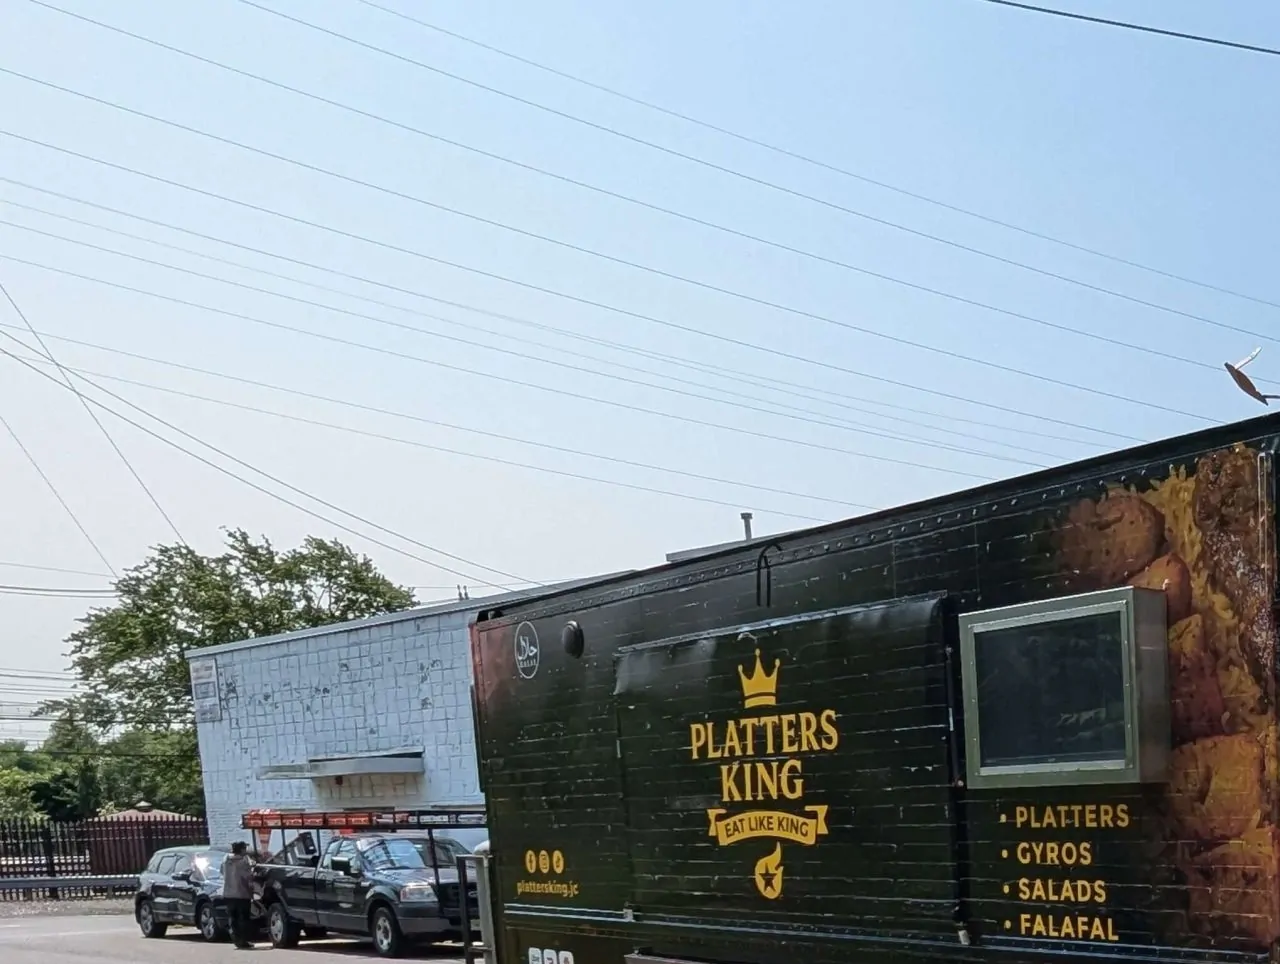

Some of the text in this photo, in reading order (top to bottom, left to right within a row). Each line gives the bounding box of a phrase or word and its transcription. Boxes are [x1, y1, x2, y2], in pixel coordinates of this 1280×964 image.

[689, 709, 839, 760] PLATTERS
[720, 759, 804, 802] KING
[724, 816, 809, 838] EAT LIKE KING
[1015, 804, 1130, 828] PLATTERS
[1017, 842, 1092, 865] GYROS
[516, 879, 580, 898] plattersking.jc
[1018, 877, 1107, 902] SALADS
[1020, 913, 1120, 941] FALAFAL
